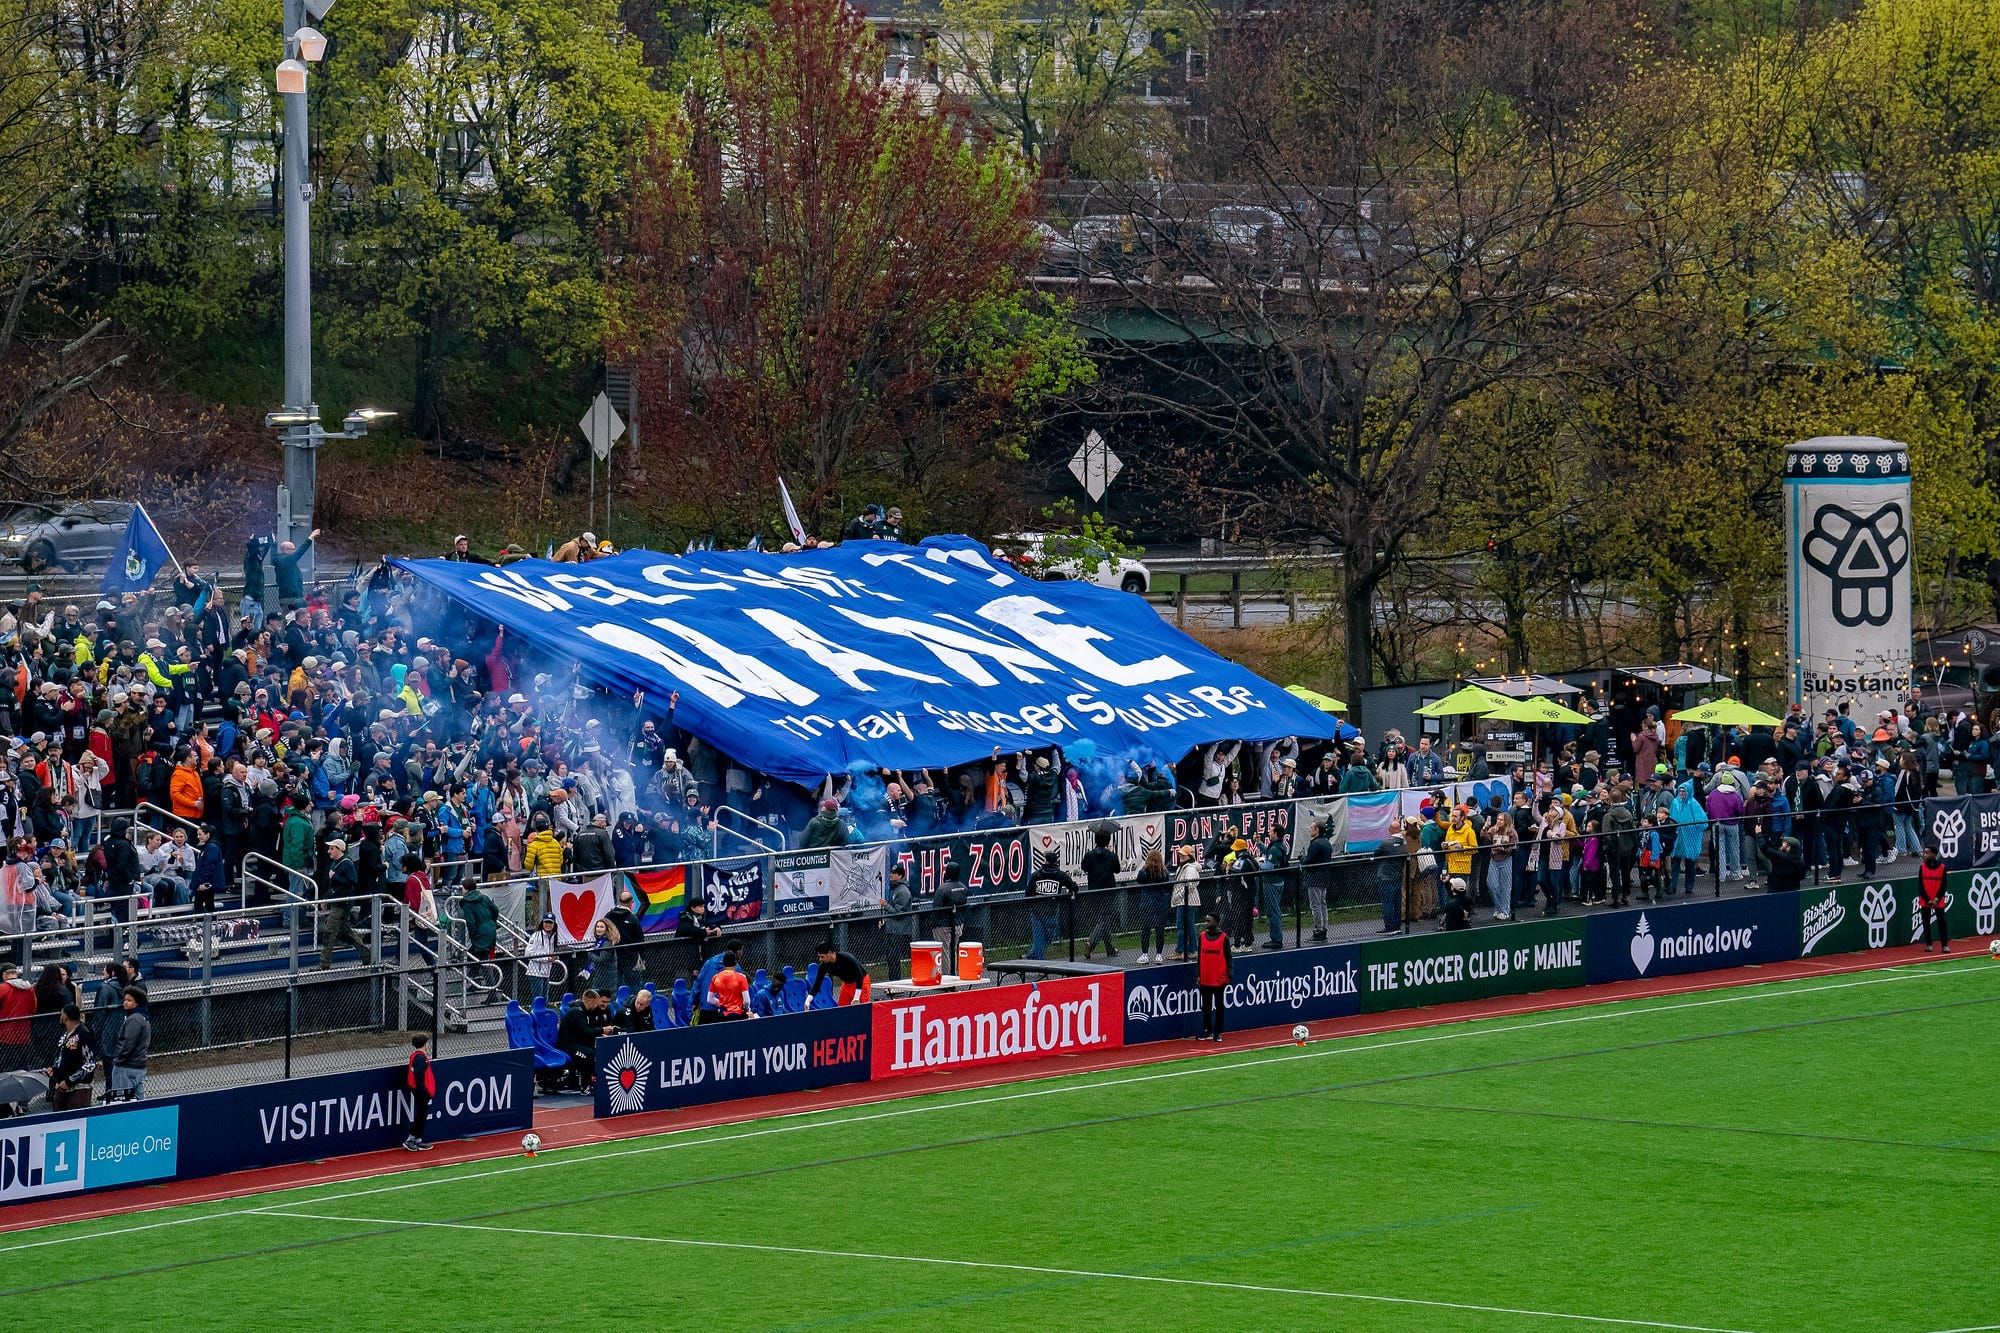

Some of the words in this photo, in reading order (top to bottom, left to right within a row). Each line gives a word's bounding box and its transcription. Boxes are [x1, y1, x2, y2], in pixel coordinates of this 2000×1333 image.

[468, 564, 905, 612] WELCM
[1803, 671, 1817, 679] the
[1804, 674, 1909, 693] substance
[769, 714, 836, 741] Th
[922, 701, 1078, 735] Soccer
[1066, 693, 1212, 732] Sould
[1189, 685, 1267, 716] Be
[1897, 693, 1910, 703] ale
[1174, 814, 1229, 841] DON'T
[775, 858, 795, 868] XTEEN
[796, 854, 827, 866] COUNTIES
[969, 839, 1024, 888] ZOO
[1170, 844, 1205, 869] TE
[782, 903, 797, 913] ONE
[798, 901, 815, 912] CLUB
[1803, 889, 1837, 927] Bissell
[1803, 904, 1843, 944] Brothers
[1368, 962, 1398, 991] THE
[1403, 954, 1463, 987] SOCCER
[1468, 948, 1508, 979] CLUB
[1513, 949, 1529, 970] OF
[1534, 939, 1582, 971] MAINE
[1152, 984, 1244, 1018] Kennec
[1246, 970, 1310, 1009] Savings
[1313, 960, 1358, 998] Bank
[660, 1056, 706, 1089] LEAD
[712, 1049, 756, 1081] WITH
[762, 1042, 807, 1074] YOUR
[813, 1033, 867, 1068] HEART
[259, 1074, 512, 1144] VISITMAIN.COM
[55, 1141, 69, 1172] 1
[91, 1141, 139, 1163] League
[143, 1135, 172, 1153] One
